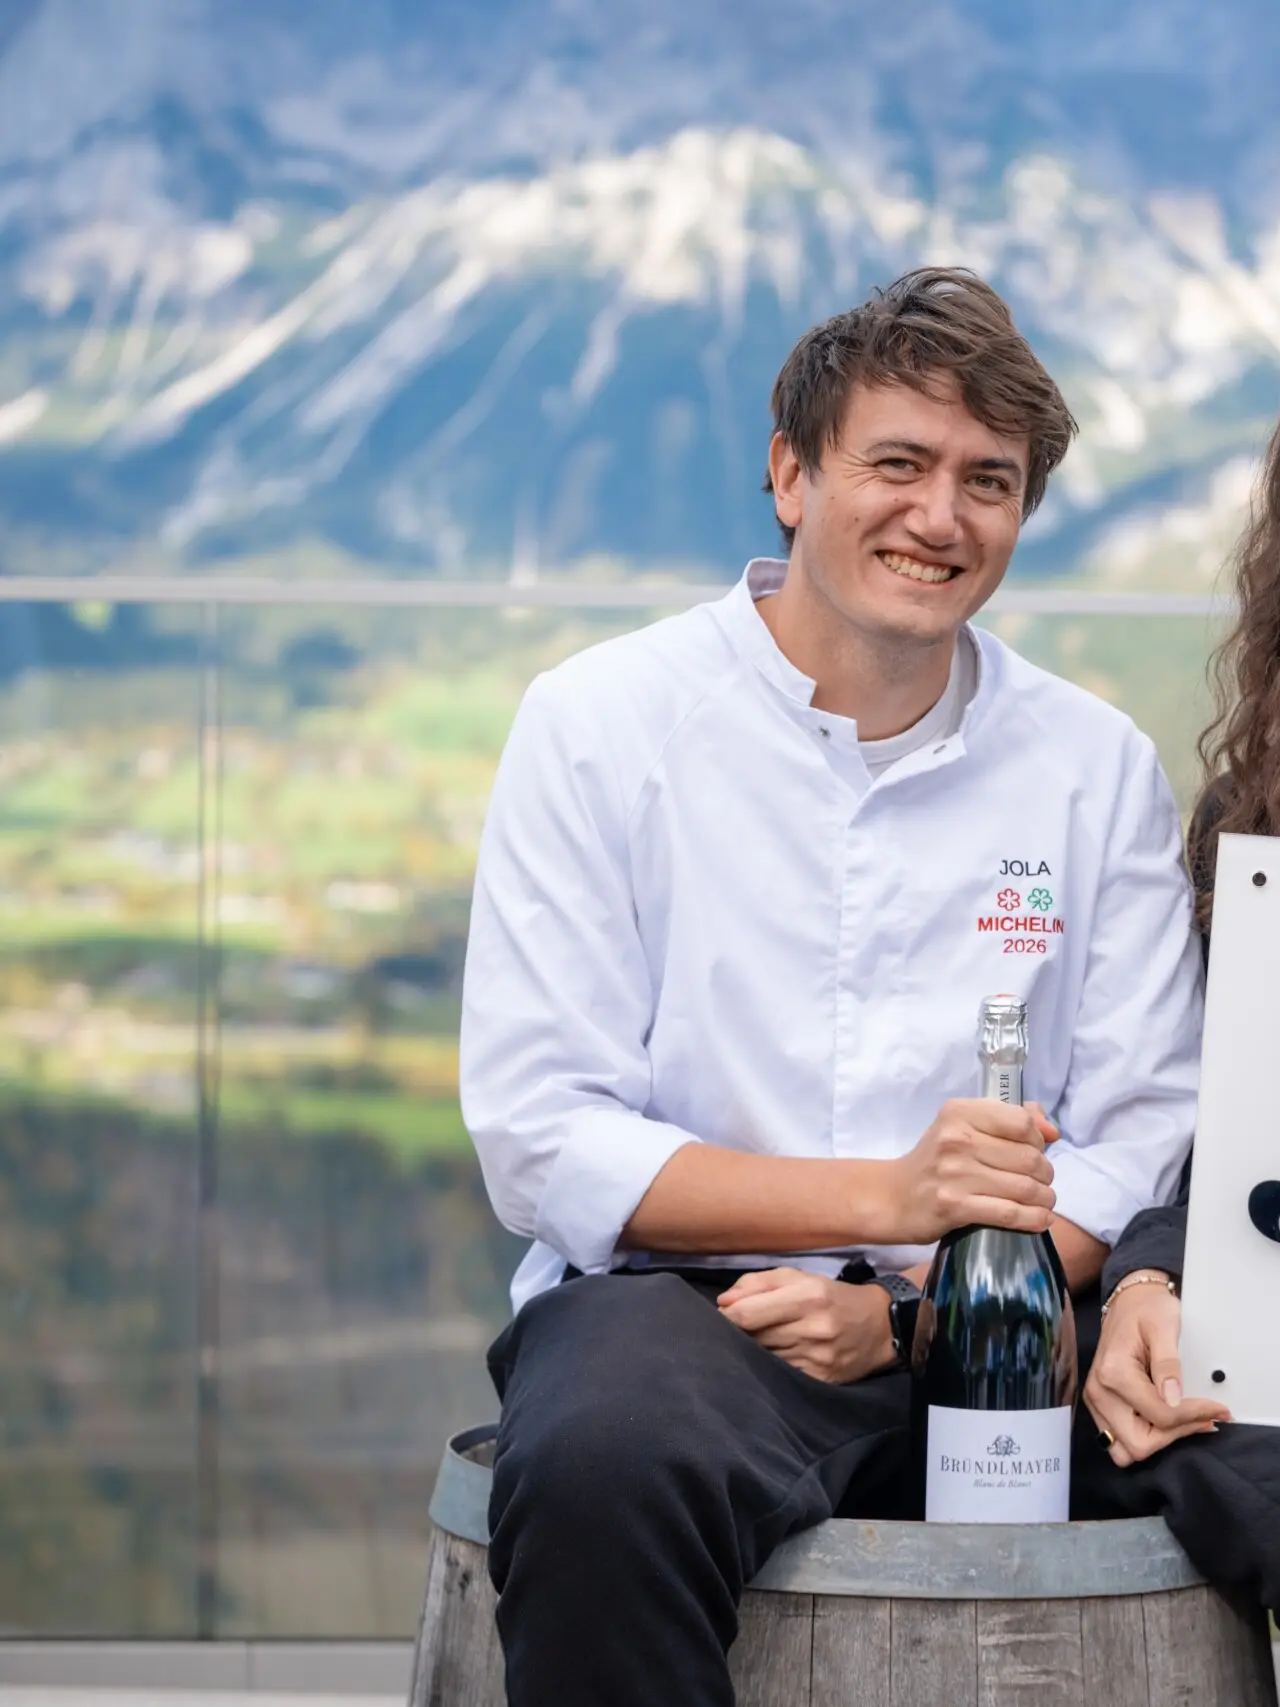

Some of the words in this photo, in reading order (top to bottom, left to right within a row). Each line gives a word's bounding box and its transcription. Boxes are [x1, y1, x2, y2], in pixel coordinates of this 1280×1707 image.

[999, 859, 1051, 876] JOLA
[978, 916, 1064, 934] MICHELIN
[1003, 939, 1047, 953] 2026
